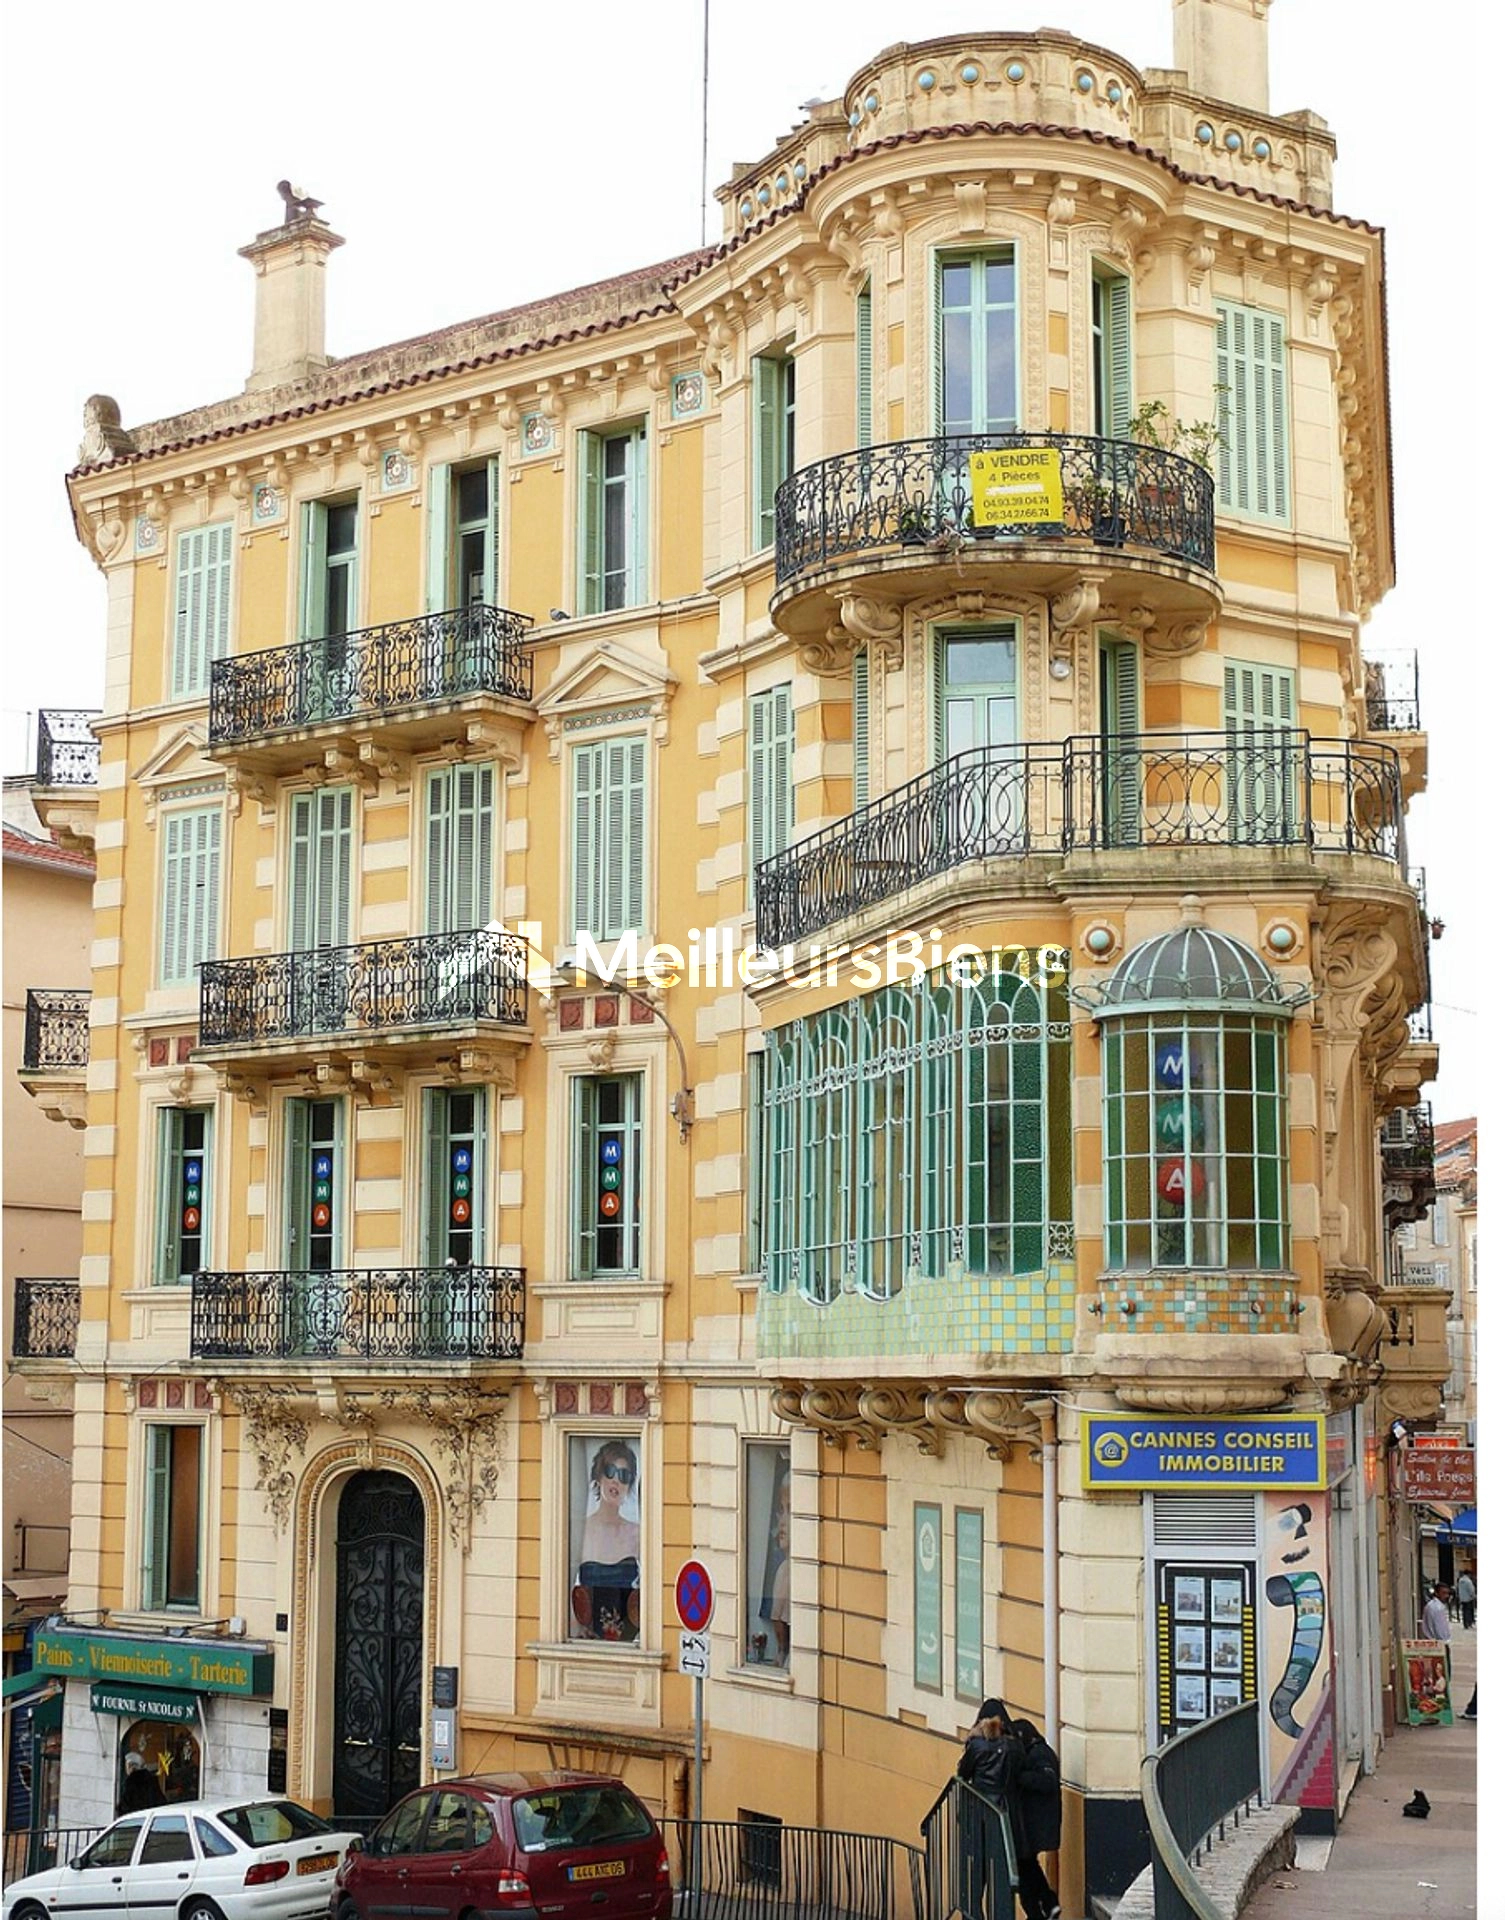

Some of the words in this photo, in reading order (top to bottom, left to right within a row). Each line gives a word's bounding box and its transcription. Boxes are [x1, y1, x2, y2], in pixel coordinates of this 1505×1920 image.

[990, 453, 1050, 468] VENDRE
[989, 473, 996, 482] 4
[1001, 470, 1041, 482] Pièces
[1130, 1431, 1217, 1449] CANNES
[1223, 1431, 1314, 1450] CONSEIL
[1159, 1454, 1285, 1473] IMMOBILIER
[36, 1640, 74, 1667] Pains
[89, 1646, 173, 1678] Viennoiserie
[189, 1655, 248, 1687] Tarterie
[102, 1695, 137, 1713] FOURNIL
[147, 1701, 183, 1717] NICOLAS
